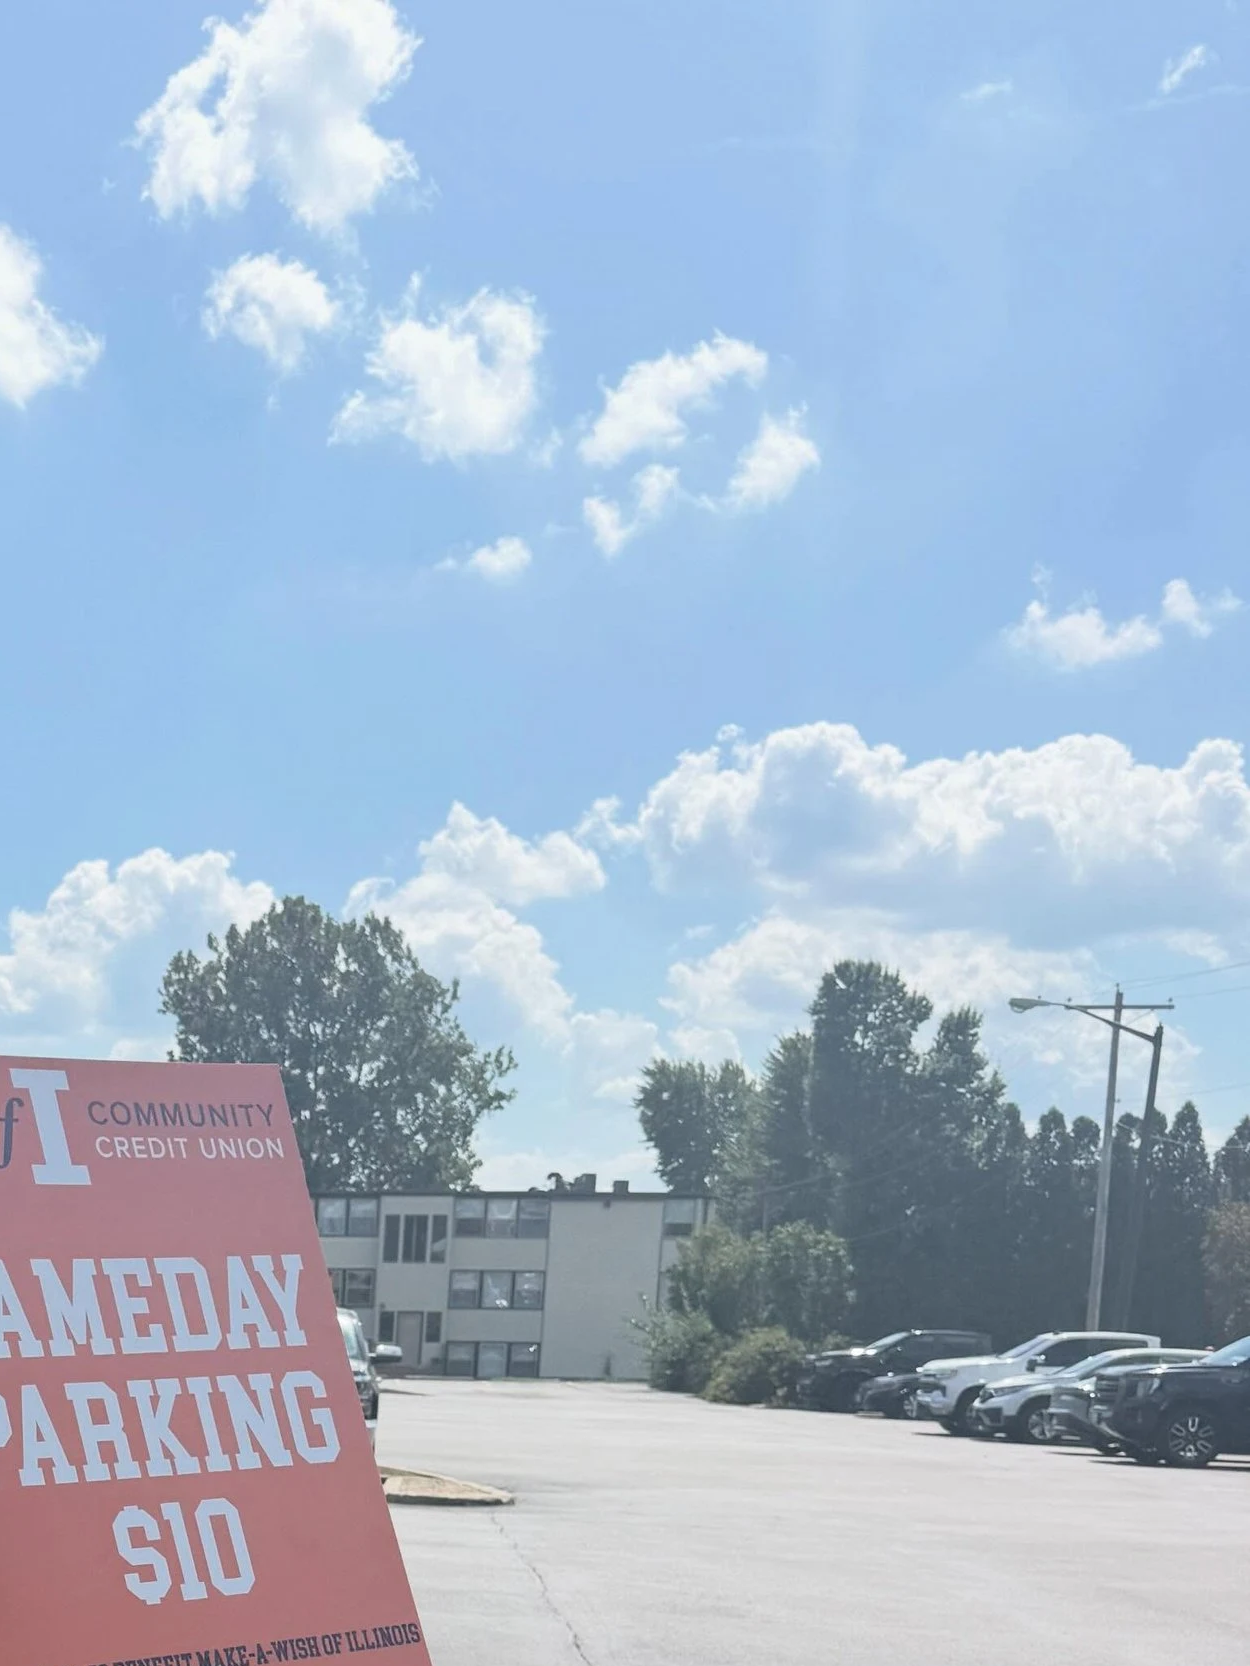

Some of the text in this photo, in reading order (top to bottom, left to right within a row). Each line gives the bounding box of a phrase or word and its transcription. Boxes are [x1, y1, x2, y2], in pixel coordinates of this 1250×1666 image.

[87, 1100, 274, 1127] COMMUNITY
[95, 1136, 284, 1160] CREDIT UNION
[112, 1497, 256, 1605] $10
[322, 1632, 343, 1656] OF
[345, 1622, 422, 1653] ILLINOIS
